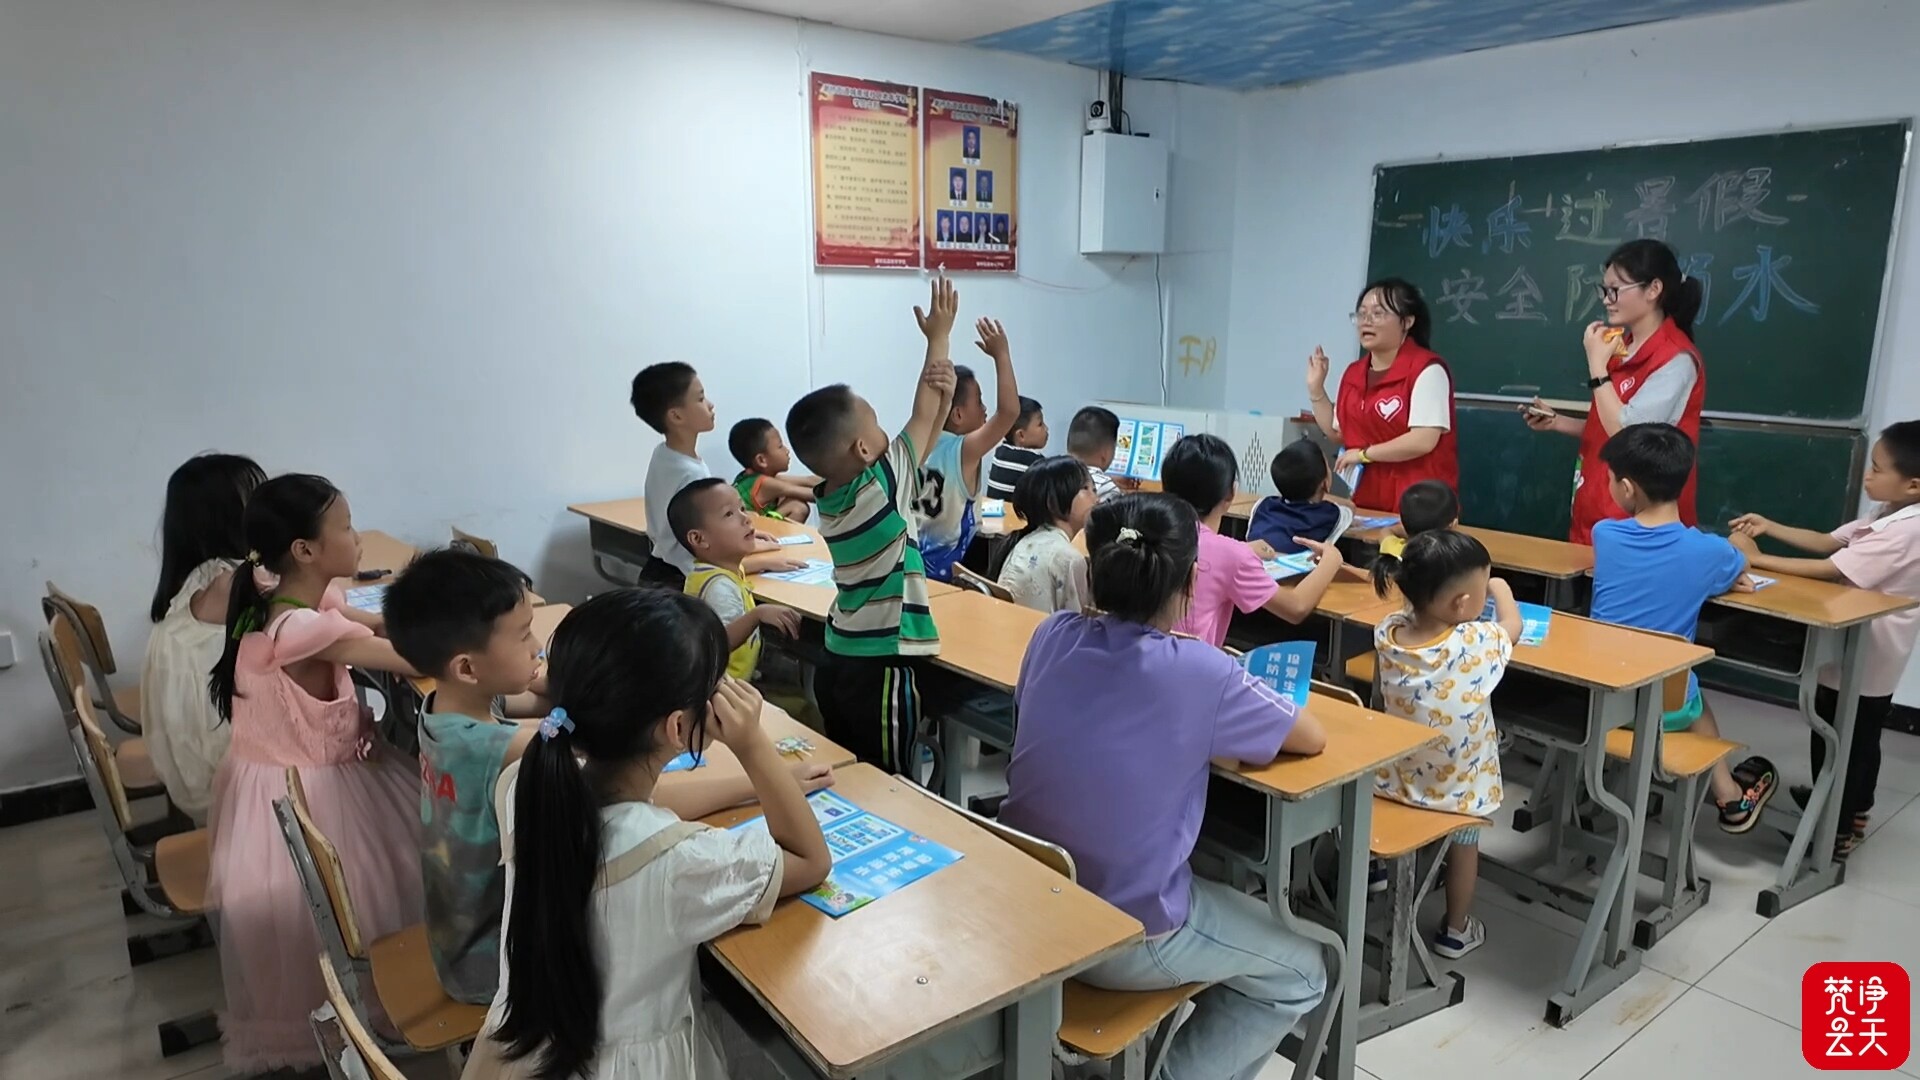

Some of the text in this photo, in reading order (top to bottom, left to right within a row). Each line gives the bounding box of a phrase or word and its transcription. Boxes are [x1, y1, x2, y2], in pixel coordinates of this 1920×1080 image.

[1422, 166, 1790, 258] 快乐过暑假
